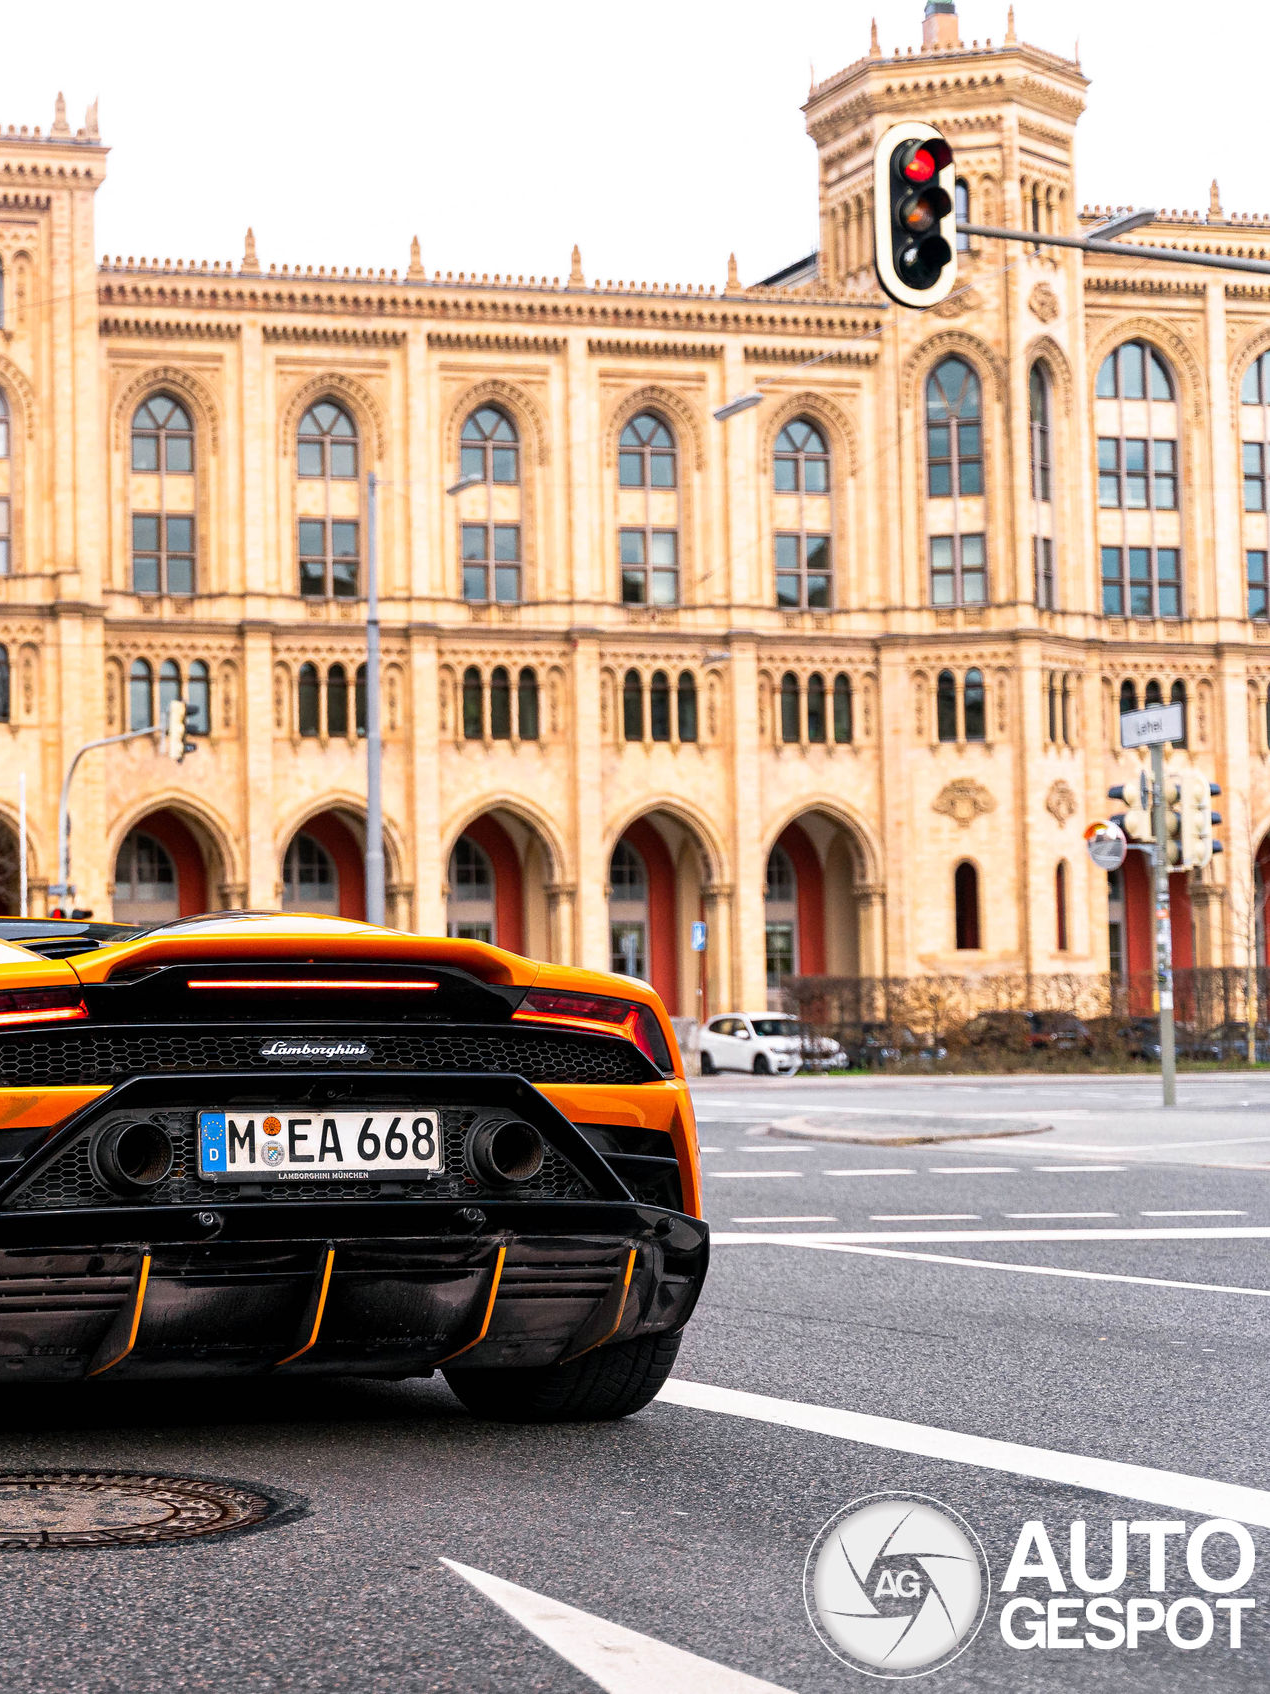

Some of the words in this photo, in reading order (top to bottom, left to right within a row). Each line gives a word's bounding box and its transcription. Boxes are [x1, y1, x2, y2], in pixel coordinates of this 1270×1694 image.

[262, 1041, 367, 1057] Lamborghini
[228, 1120, 256, 1164] M
[288, 1118, 344, 1163] EA
[357, 1117, 436, 1161] 668
[209, 1148, 220, 1161] D
[278, 1172, 330, 1180] LAMBORGHINI
[332, 1170, 369, 1179] MÜNCHEN
